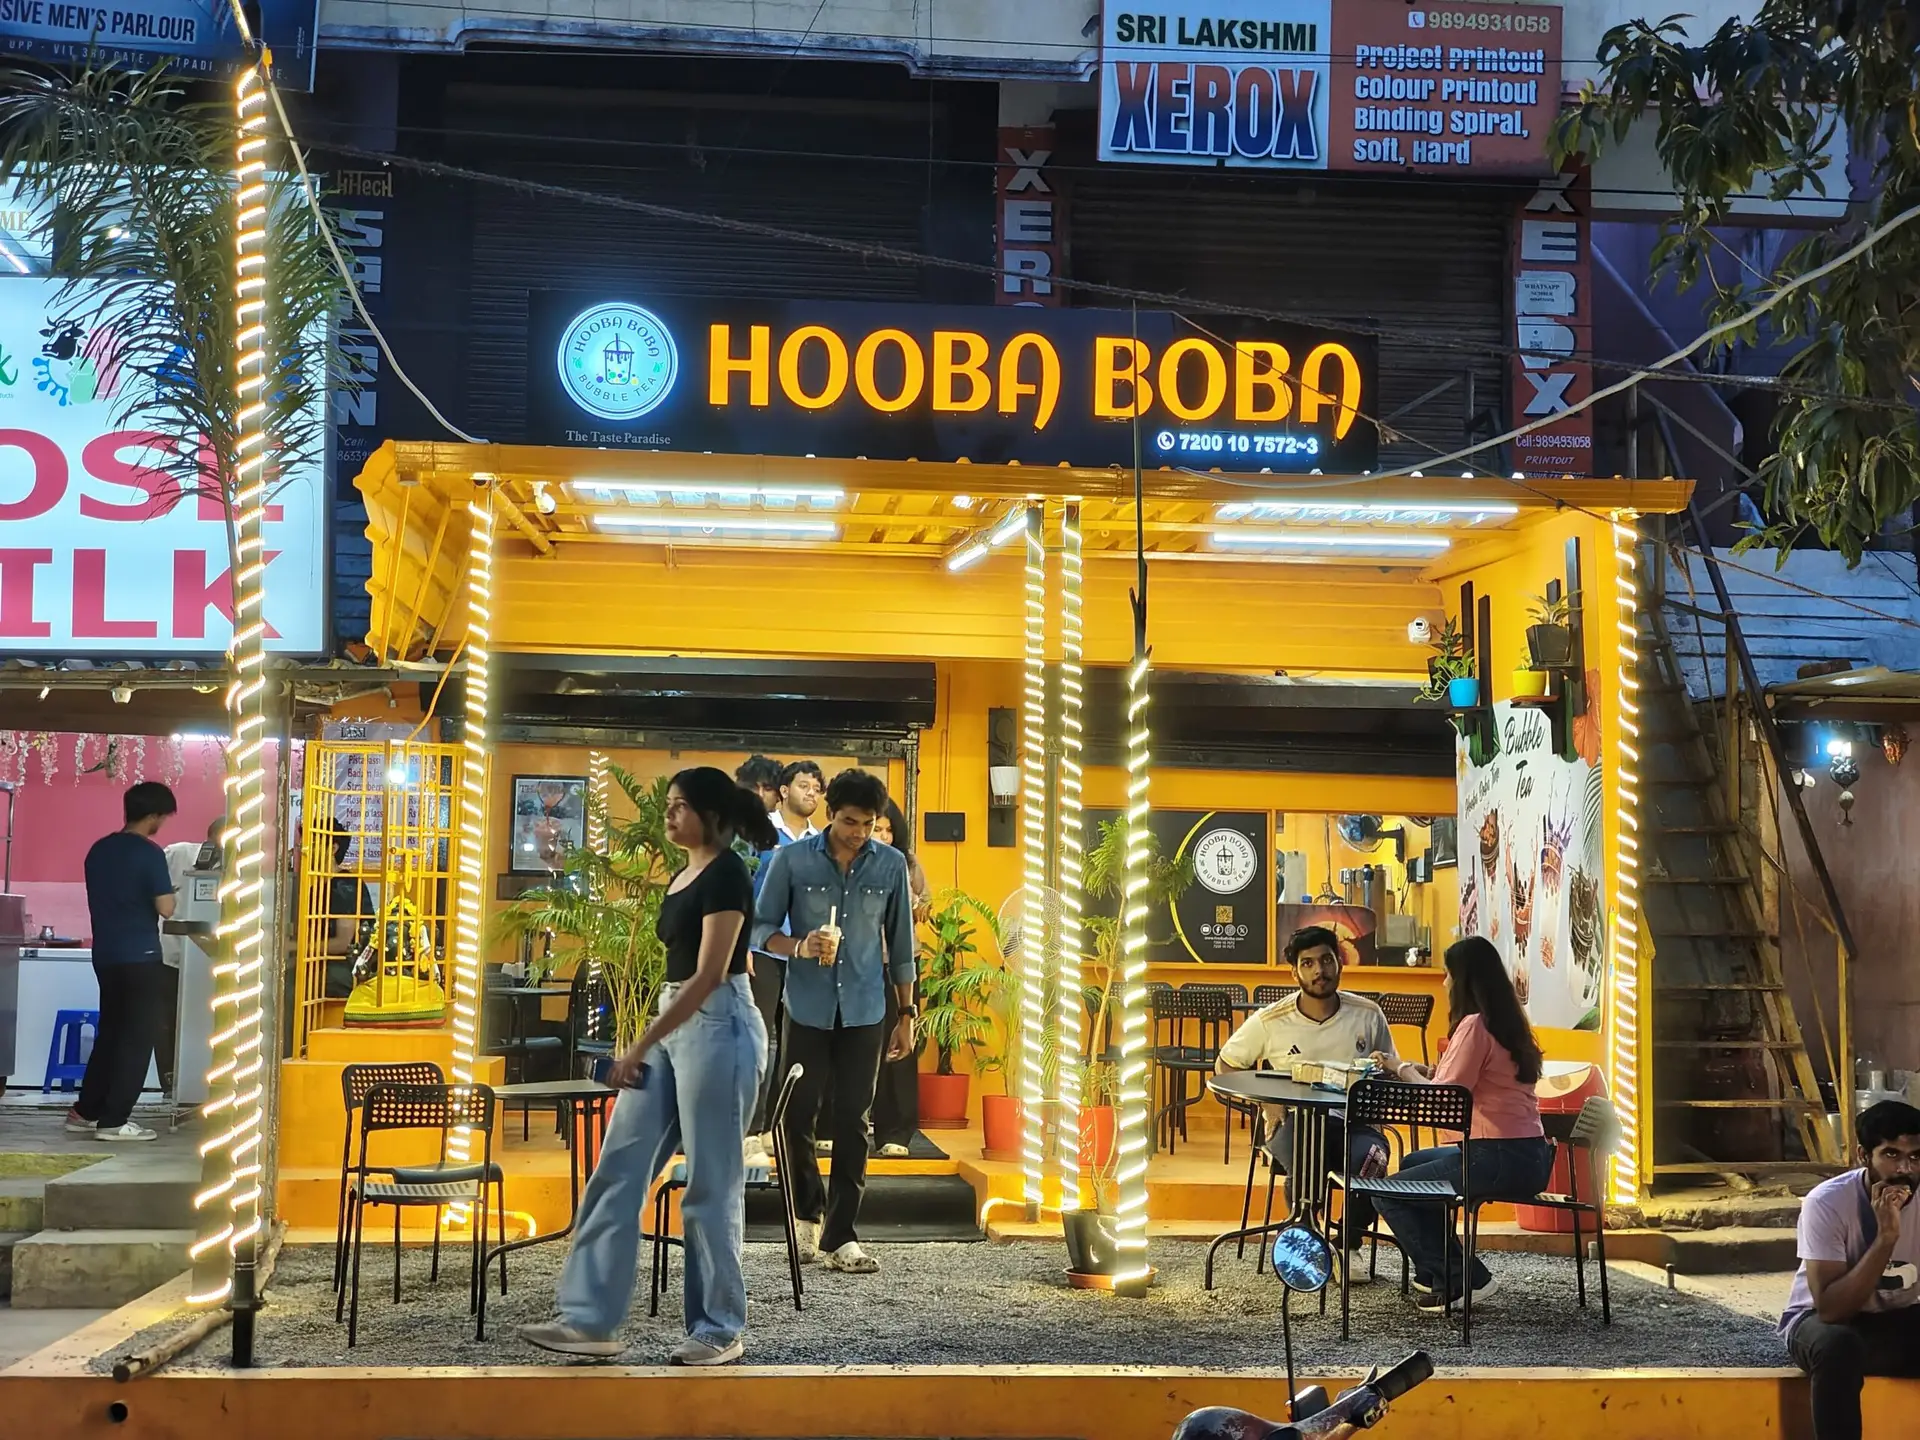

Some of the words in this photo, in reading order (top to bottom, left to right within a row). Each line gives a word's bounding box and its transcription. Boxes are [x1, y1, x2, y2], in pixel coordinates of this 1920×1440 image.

[48, 3, 107, 32] MEN'S
[112, 10, 195, 42] PARLOUR
[1116, 13, 1166, 45] SRI
[1178, 17, 1317, 52] LAKSHMI
[1428, 11, 1551, 34] 9894931058
[1355, 44, 1442, 73] Project
[1449, 46, 1544, 75] Printout
[1355, 75, 1435, 100] Colour
[1441, 77, 1538, 105] Printout
[1109, 60, 1320, 159] XEROX
[1354, 106, 1443, 136] Binding
[1450, 109, 1529, 138] Spiral,
[1353, 137, 1407, 165] Soft,
[1412, 140, 1470, 165] Hard
[1004, 148, 1051, 307] XER
[574, 316, 623, 352] HOOBA
[627, 319, 660, 357] BOBA
[578, 374, 629, 402] BUBBLE
[633, 377, 657, 397] TEA
[709, 323, 1061, 431] HOOBA
[1094, 336, 1361, 441] BOBA
[566, 430, 588, 442] The
[591, 431, 622, 443] Taste
[624, 432, 672, 445] Paradise
[1179, 434, 1223, 451] 7200
[1227, 434, 1249, 452] 10
[1525, 455, 1575, 465] PRINTOUT
[1504, 709, 1546, 758] Bubble
[1516, 759, 1535, 801] Tea
[346, 808, 370, 818] Mano
